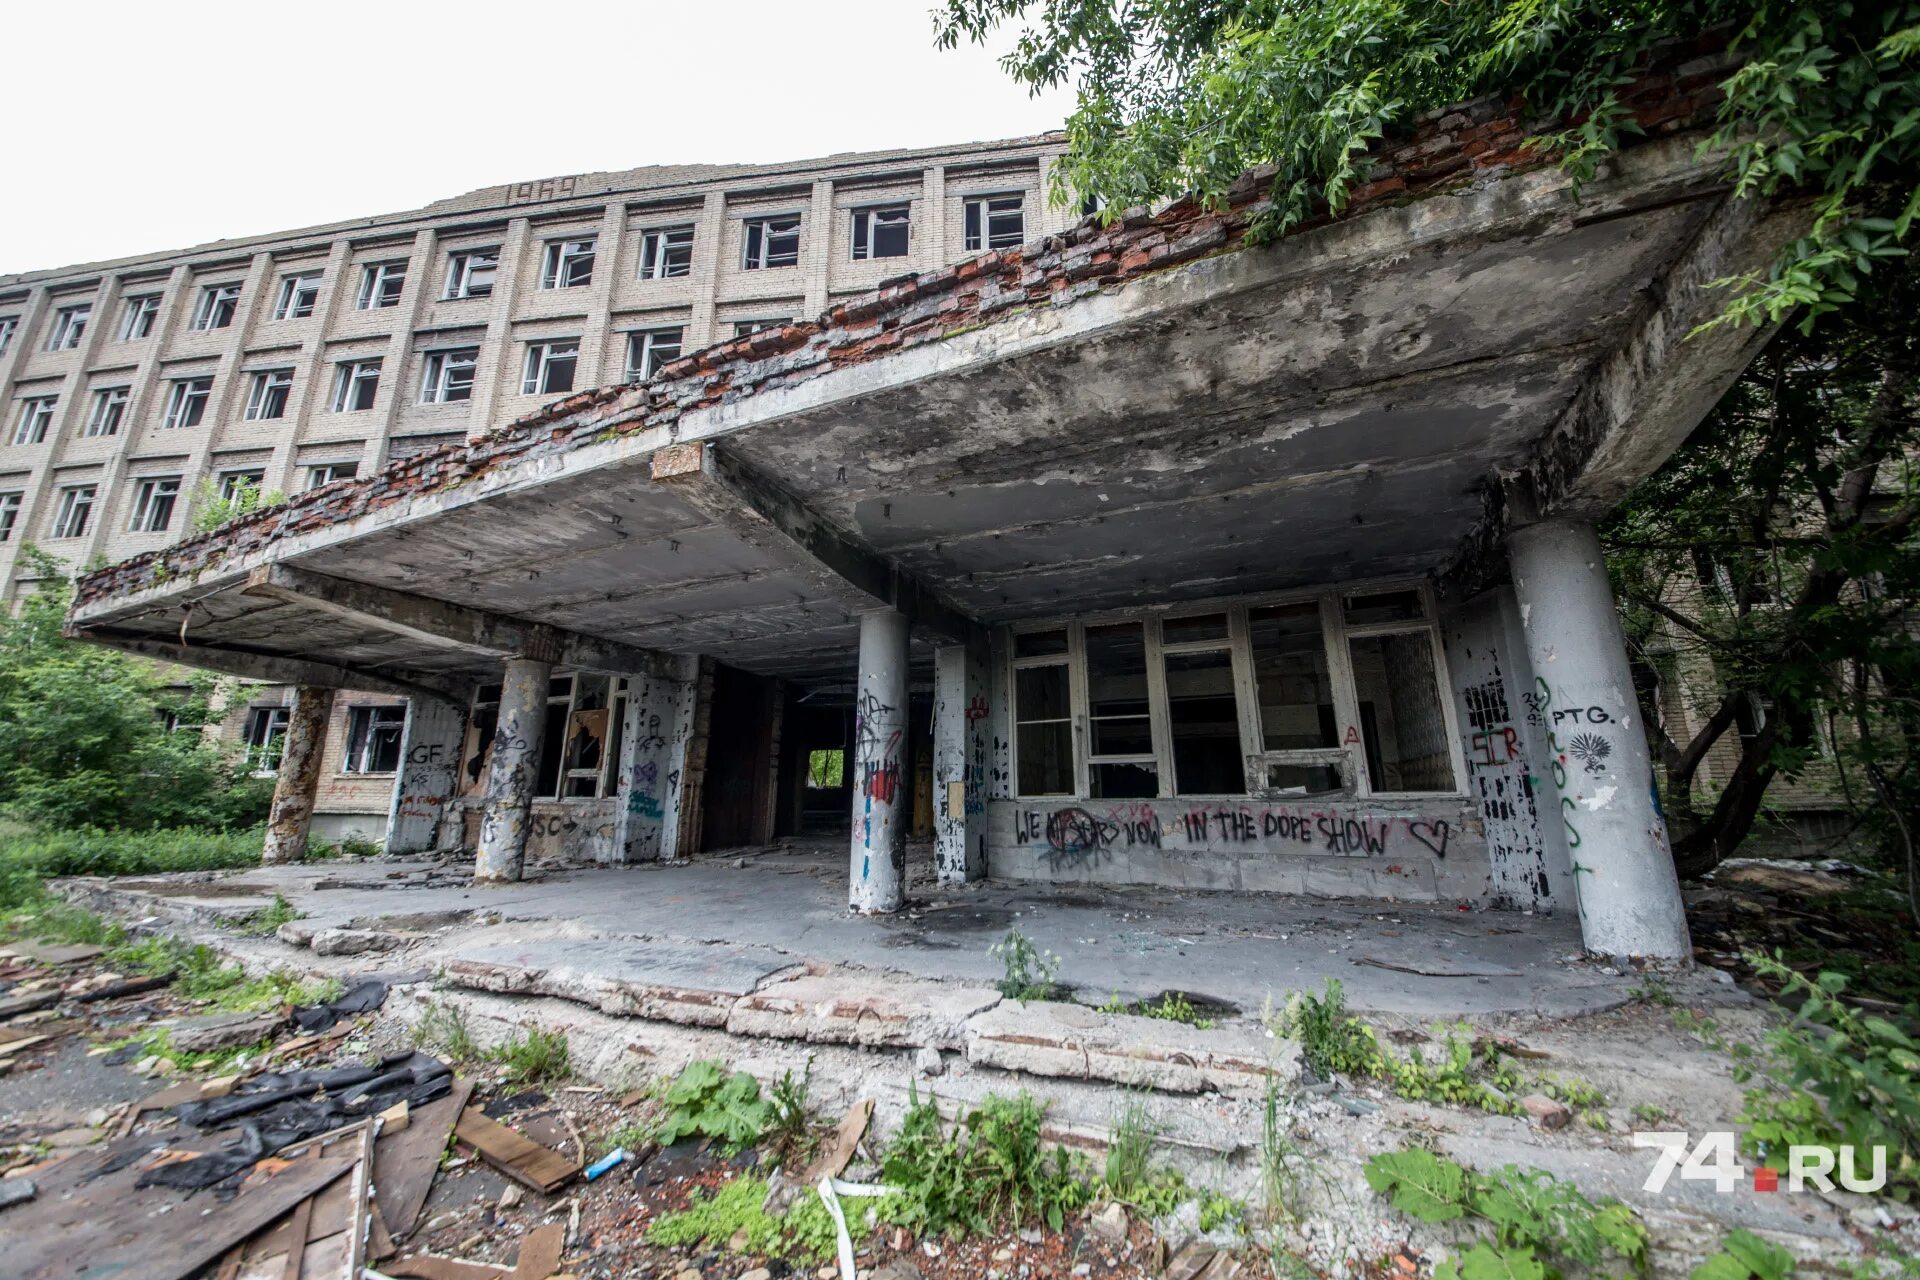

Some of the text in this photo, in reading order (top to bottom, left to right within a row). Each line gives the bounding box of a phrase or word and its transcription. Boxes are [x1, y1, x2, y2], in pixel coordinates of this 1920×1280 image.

[505, 176, 577, 206] 1969
[1015, 809, 1040, 844] WE
[1124, 814, 1161, 849] NOW
[1184, 812, 1208, 842] IN
[1213, 811, 1257, 842] THE
[1263, 813, 1312, 842] DOPE
[1317, 817, 1387, 855] SHOW
